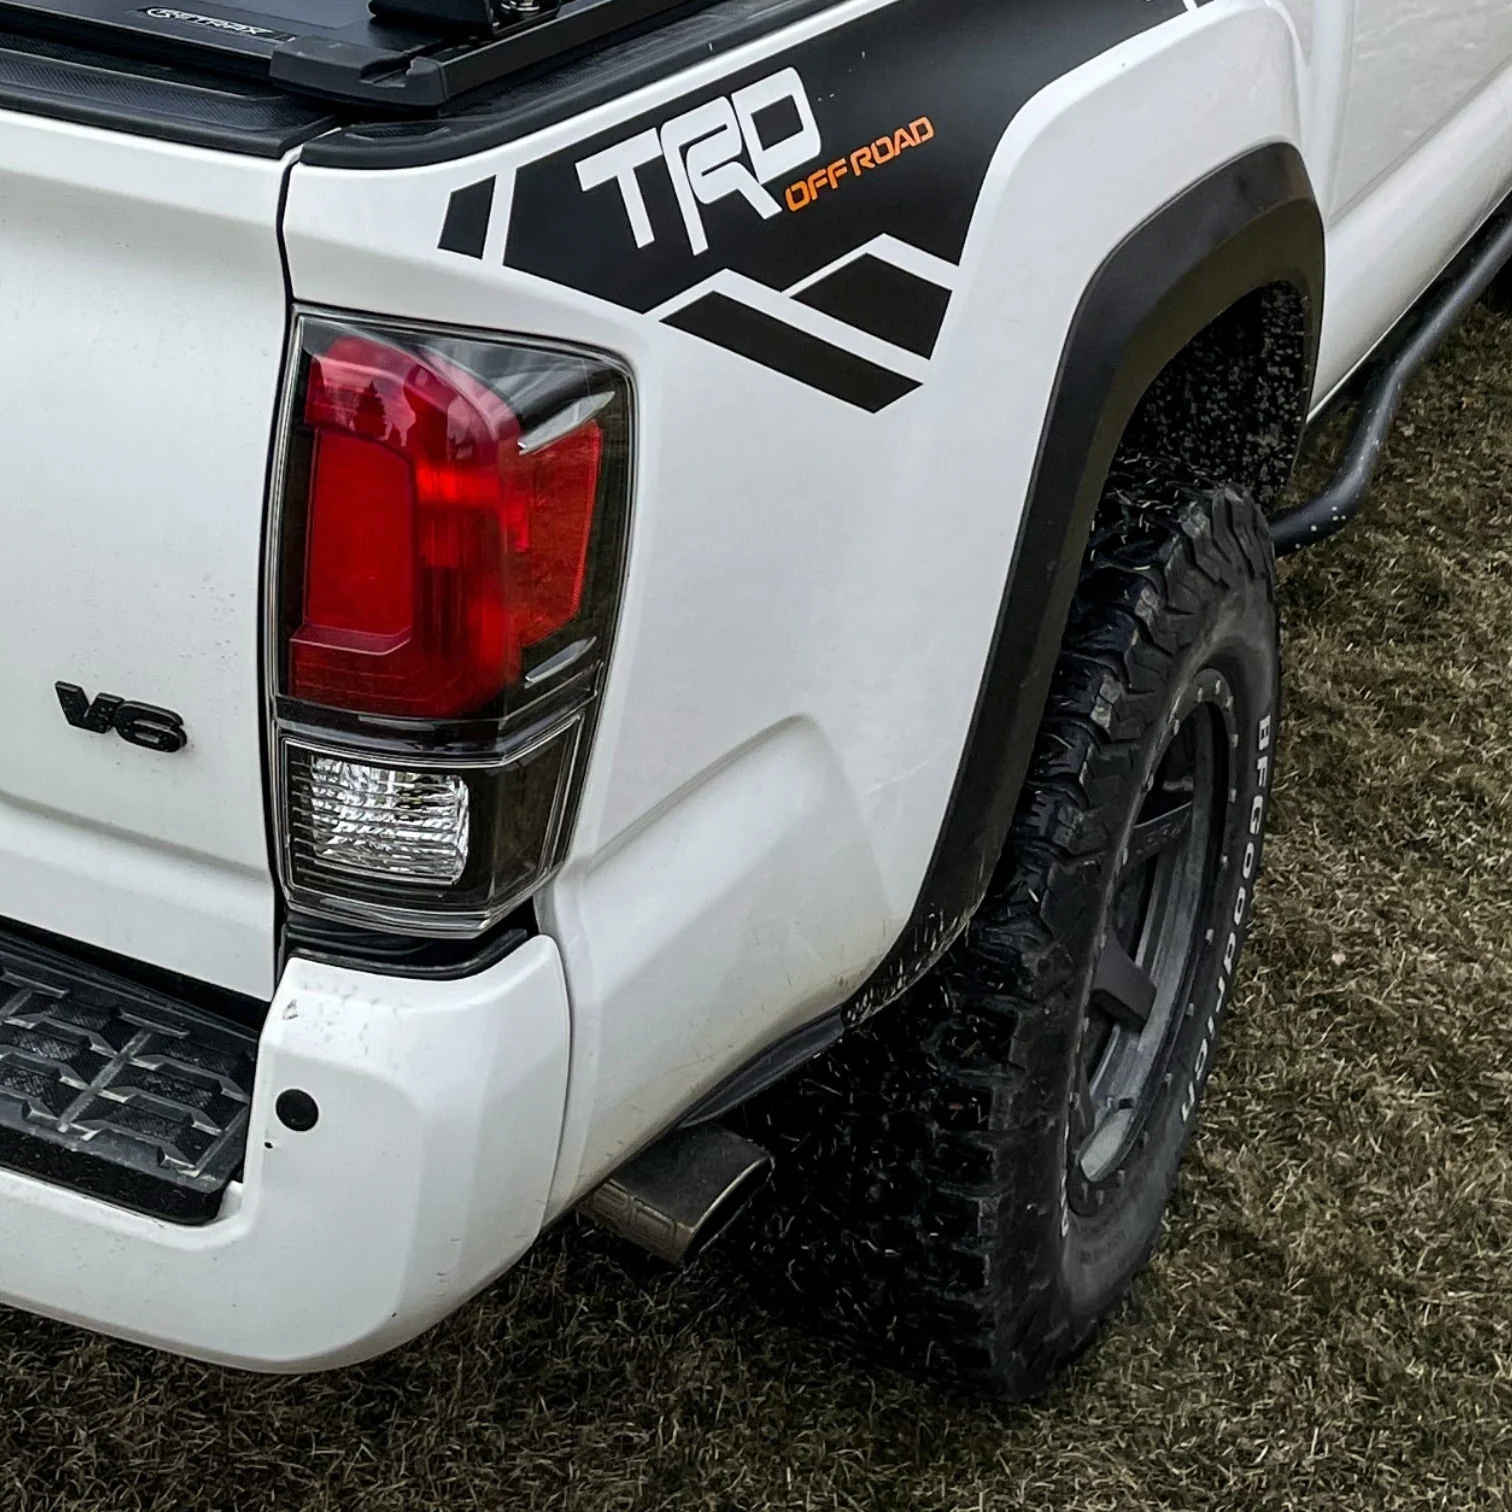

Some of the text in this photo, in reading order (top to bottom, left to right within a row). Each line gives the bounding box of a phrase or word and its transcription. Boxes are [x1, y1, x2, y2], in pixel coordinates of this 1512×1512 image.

[575, 67, 821, 256] TRD
[785, 116, 935, 212] OFF ROAD
[54, 680, 188, 753] V6
